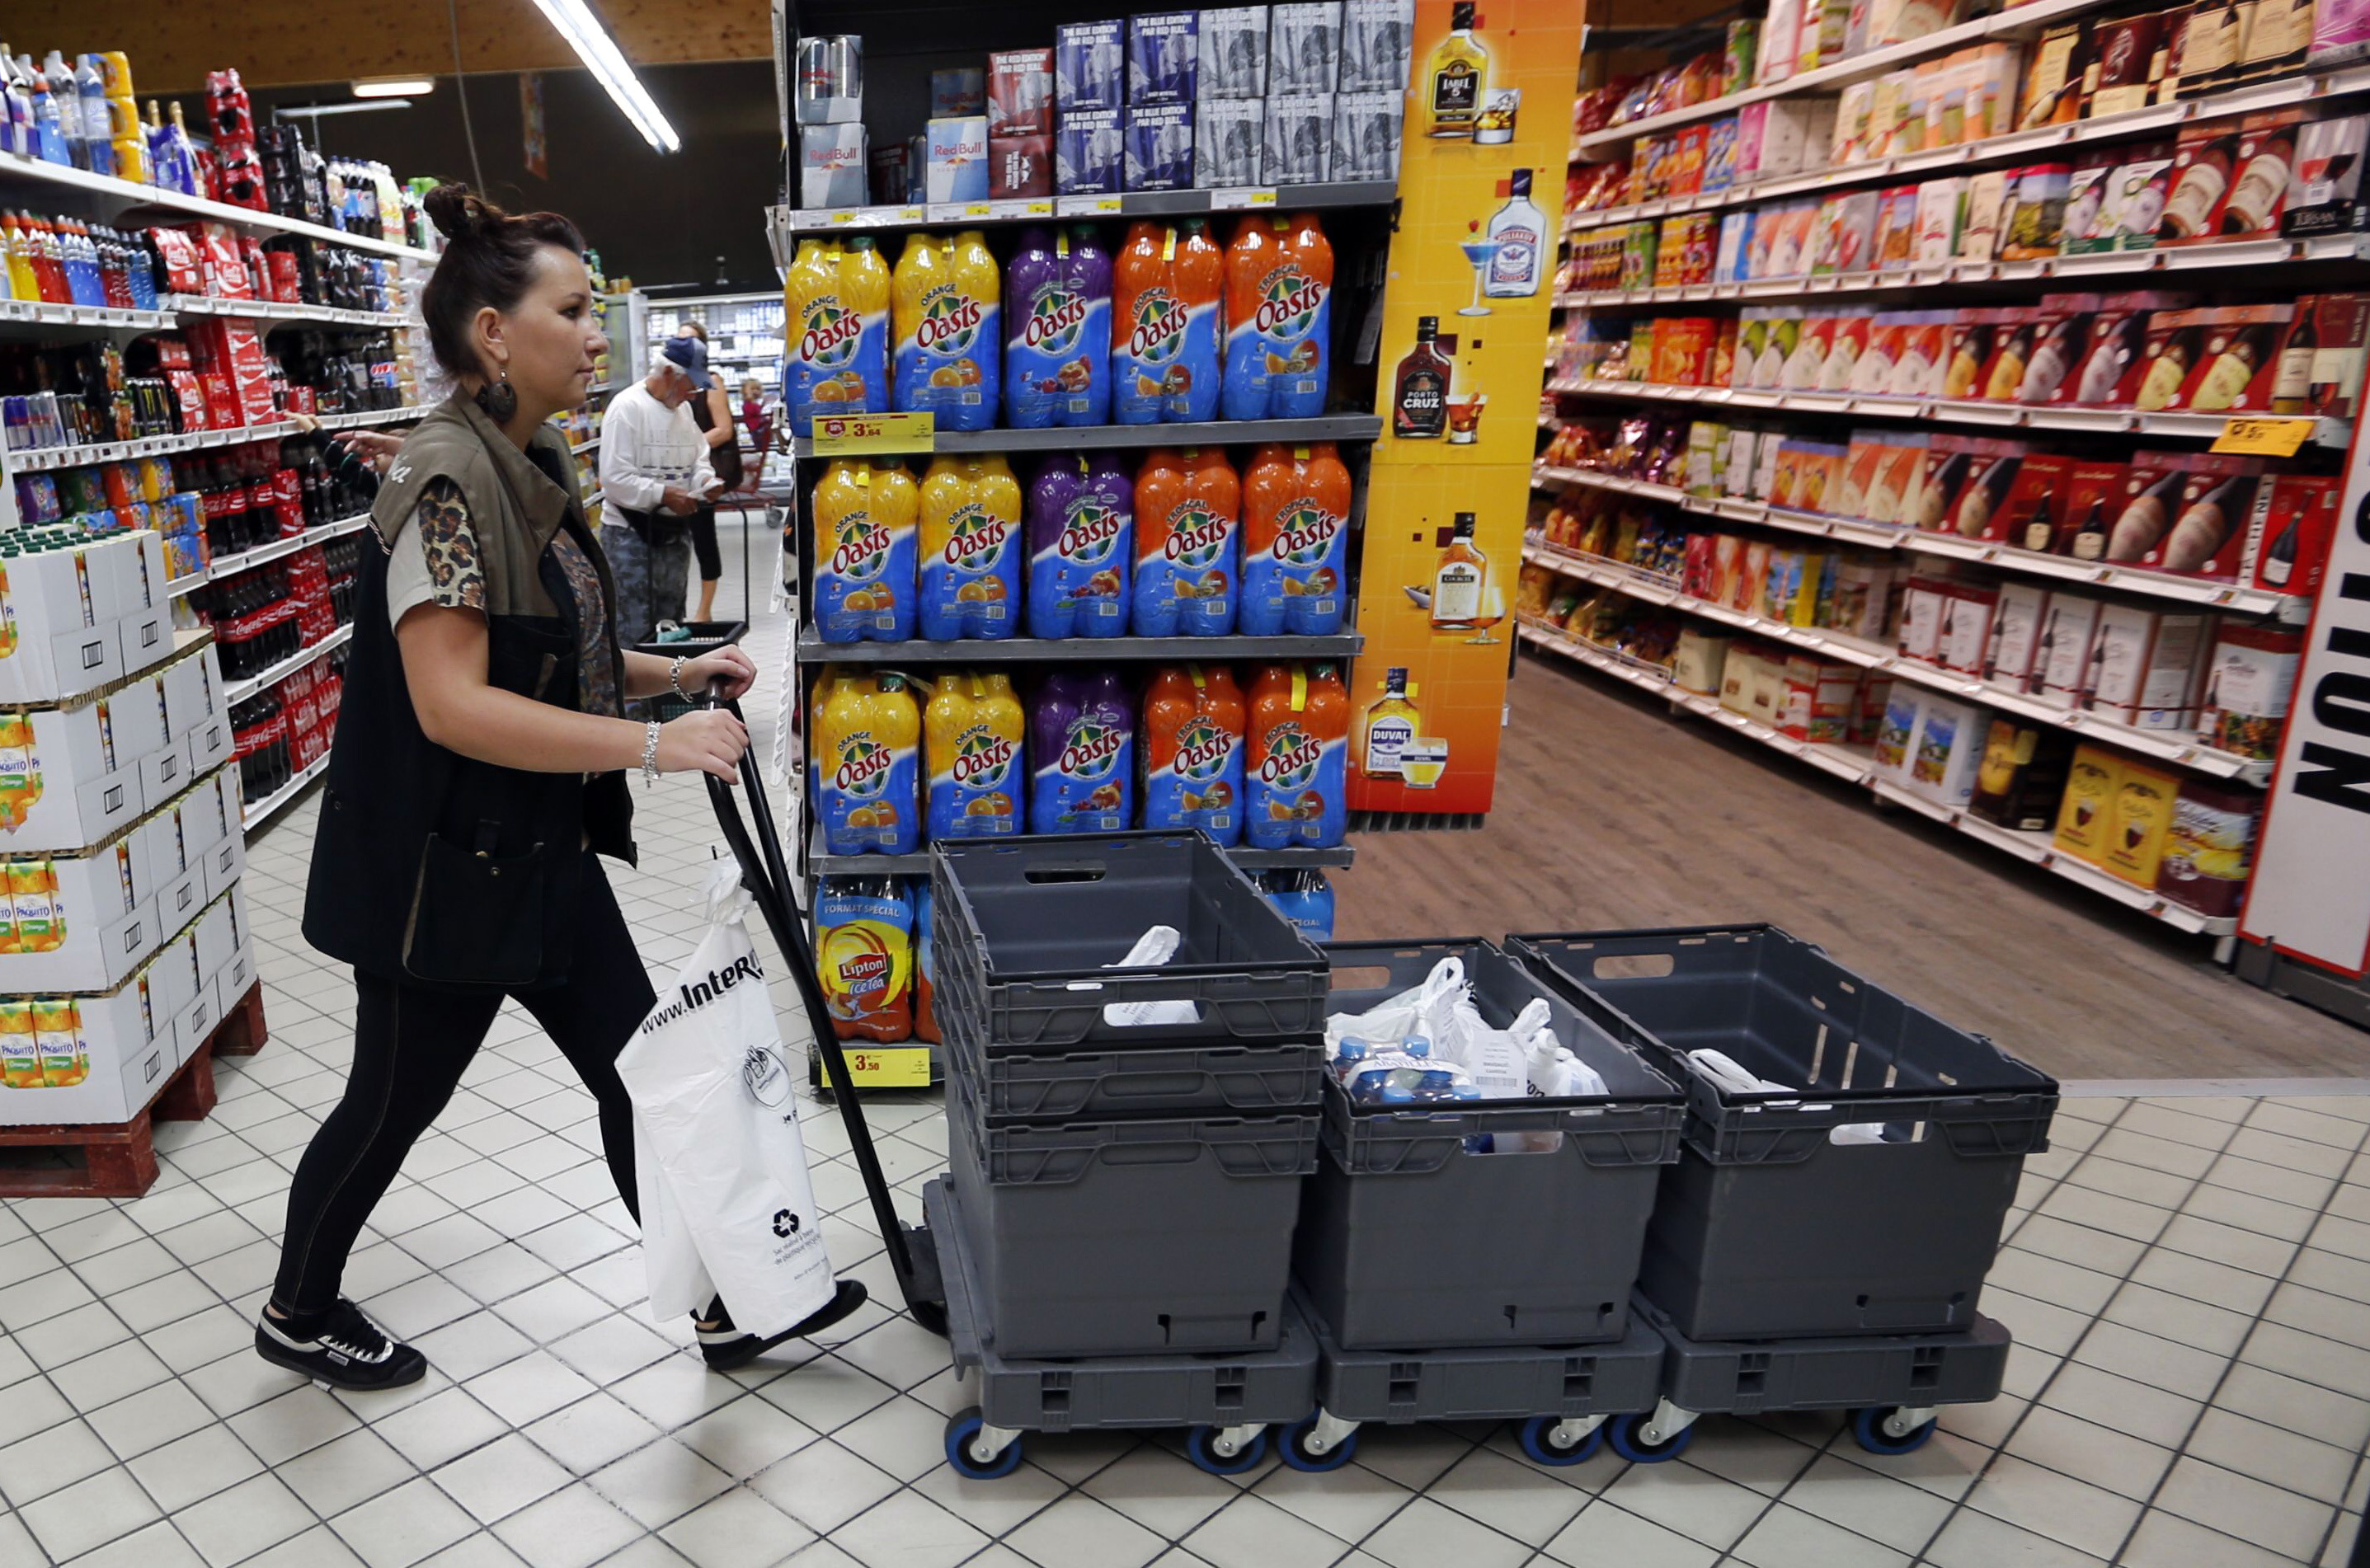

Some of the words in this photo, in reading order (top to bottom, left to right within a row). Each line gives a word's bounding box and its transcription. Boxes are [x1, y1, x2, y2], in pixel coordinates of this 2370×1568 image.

[1092, 25, 1117, 35] EDITION
[1137, 18, 1148, 26] THE
[1167, 15, 1192, 25] EDITION
[996, 55, 1007, 63] THE
[1008, 54, 1020, 63] RED
[1022, 54, 1046, 63] EDITION
[1442, 77, 1471, 90] LABEL
[1064, 113, 1074, 121] THE
[1093, 110, 1117, 119] EDITION
[1132, 109, 1143, 117] THE
[1161, 106, 1187, 115] EDITION
[1258, 264, 1300, 291] TROPICAL
[802, 295, 838, 318] ORANGE
[921, 284, 956, 306] ORANGE
[1133, 288, 1169, 317] TROPICAL
[1256, 277, 1321, 332] Oasis
[917, 296, 980, 347] Oasis
[1025, 293, 1086, 347] Oasis
[1131, 298, 1188, 357] Oasis
[801, 308, 861, 361] Oasis
[1403, 398, 1440, 409] CRUZ
[835, 510, 868, 533] ORANGE
[948, 503, 984, 525] ORANGE
[1166, 500, 1208, 523] TROPICAL
[1275, 498, 1318, 522] TROPICAL
[944, 514, 1006, 564] Oasis
[1059, 509, 1120, 557] Oasis
[1164, 513, 1227, 561] Oasis
[1272, 511, 1336, 561] Oasis
[832, 523, 890, 574] Oasis
[955, 725, 990, 746] ORANGE
[1175, 716, 1213, 740] TROPICAL
[1264, 721, 1300, 747] TROPICAL
[1373, 730, 1408, 740] DUVAL
[838, 731, 872, 752] ORANGE
[1059, 726, 1121, 774] Oasis
[1173, 728, 1232, 775] Oasis
[835, 742, 891, 790] Oasis
[952, 736, 1012, 782] Oasis
[1261, 735, 1321, 782] Oasis
[16, 907, 49, 918] PAQUITO
[825, 904, 862, 914] FORMAT
[841, 960, 884, 977] Lipton
[642, 948, 764, 1034] www.InteR
[2, 1045, 35, 1054] PAQUITO
[40, 1044, 73, 1054] PAQUITO
